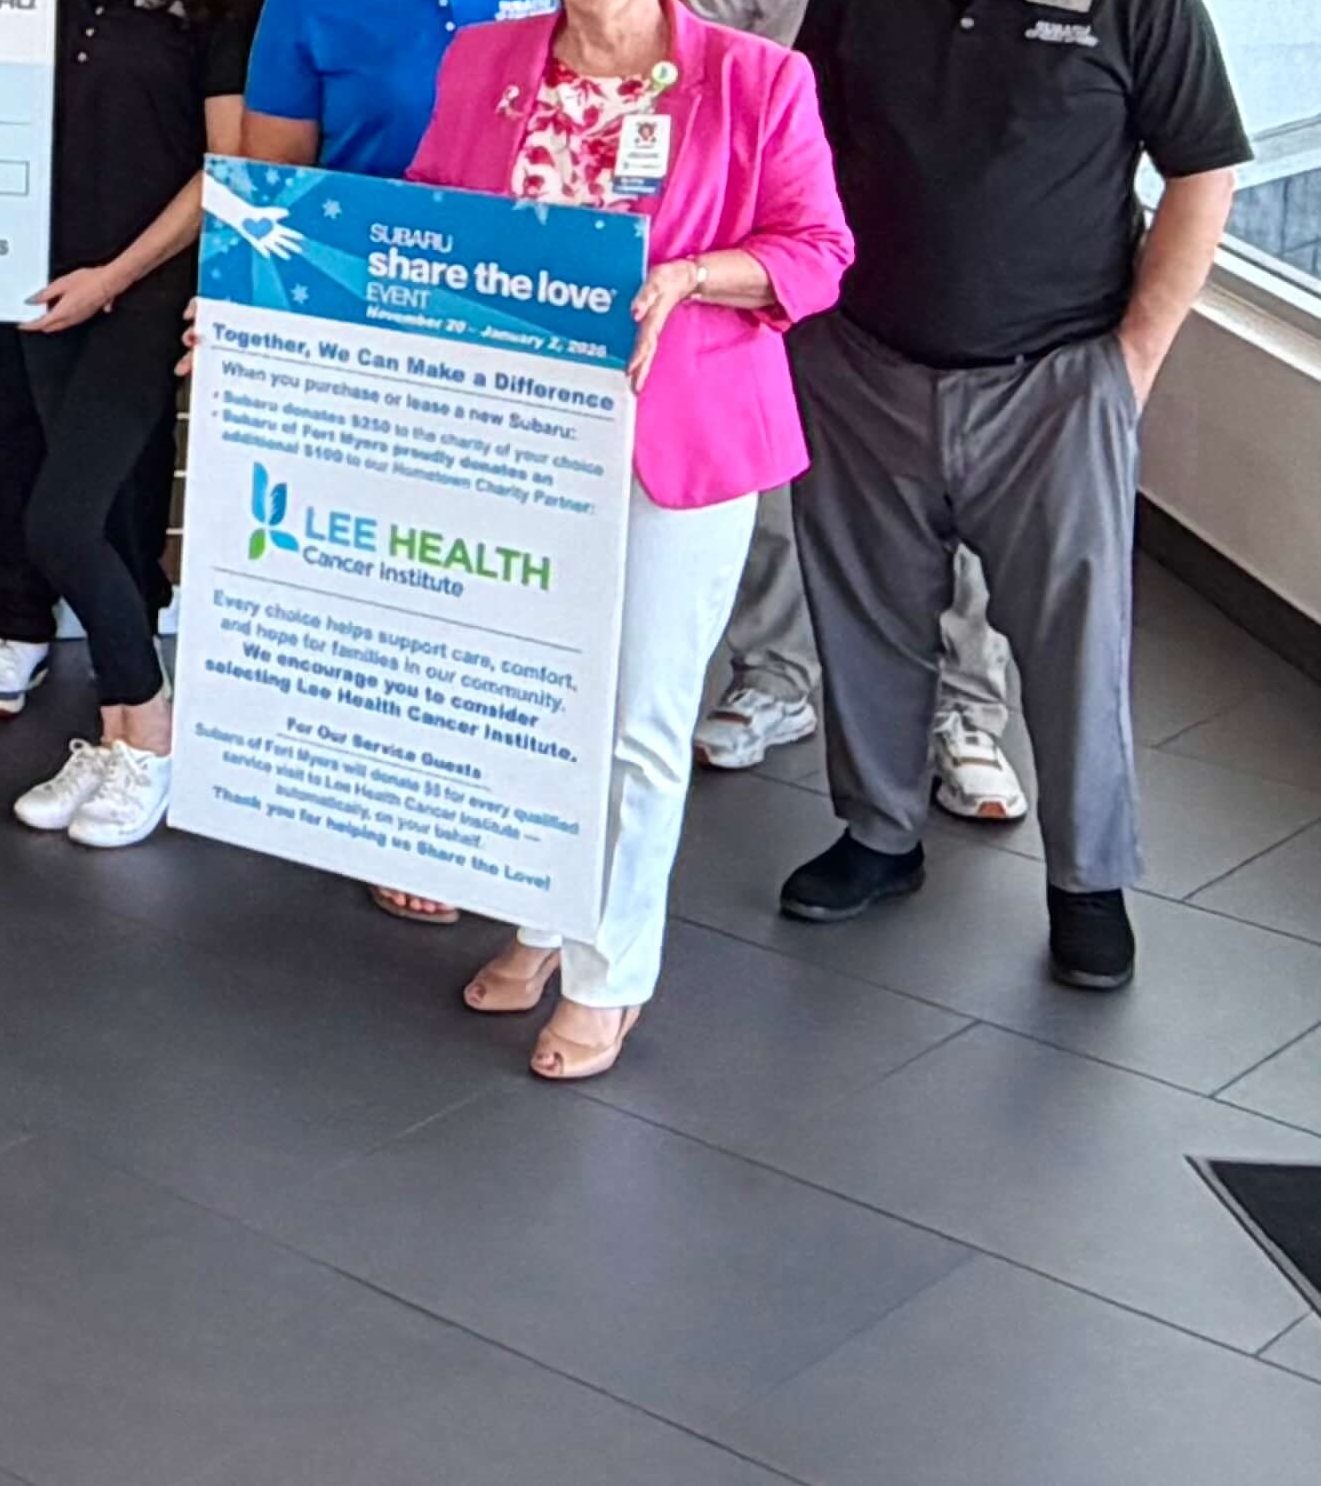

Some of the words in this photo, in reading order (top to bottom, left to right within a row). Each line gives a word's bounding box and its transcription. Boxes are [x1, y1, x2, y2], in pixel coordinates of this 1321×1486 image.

[368, 246, 469, 290] share
[473, 262, 533, 301] the
[537, 270, 615, 313] love
[370, 223, 453, 254] SUBARU
[366, 281, 431, 309] EVENT
[212, 321, 311, 359] Together,
[317, 340, 351, 363] We
[357, 347, 400, 372] Can
[406, 356, 466, 383] Make
[472, 372, 487, 388] a
[493, 371, 615, 411] Difference
[221, 360, 267, 382] When
[269, 372, 301, 389] you
[303, 377, 381, 404] purchase
[383, 392, 403, 407] or
[405, 393, 451, 417] lease
[453, 405, 466, 420] a
[468, 408, 505, 427] new
[508, 411, 576, 441] Subaru:
[221, 407, 278, 432] Subaru
[280, 421, 298, 435] of
[301, 423, 336, 443] Fort
[338, 430, 390, 454] Myers
[391, 443, 456, 470] proudly
[458, 455, 528, 482] donates
[531, 471, 555, 487] an
[221, 429, 300, 455] additional
[344, 452, 362, 468] to
[363, 457, 389, 473] our
[391, 460, 472, 490] Hometown
[474, 477, 530, 505] Charity
[532, 488, 596, 515] Partner:
[222, 389, 279, 413] Subaru
[281, 401, 347, 426] donates
[394, 423, 410, 438] to
[411, 426, 437, 443] the
[439, 433, 492, 455] charity
[493, 442, 511, 457] of
[514, 449, 550, 465] your
[551, 455, 605, 477] choice
[301, 544, 375, 577] Cancer
[379, 561, 465, 598] Institute
[304, 505, 378, 553] LEE
[388, 523, 551, 592] HEALTH
[213, 588, 261, 618] Every
[264, 603, 323, 630] choice
[325, 615, 374, 642] helps
[377, 630, 448, 660] support
[450, 648, 496, 673] care,
[219, 617, 252, 637] and
[255, 622, 300, 648] hope
[301, 632, 327, 654] for
[331, 639, 400, 672] families
[403, 655, 421, 676] in
[424, 666, 457, 685] our
[460, 673, 566, 714] community.
[205, 658, 292, 695] selecting
[296, 677, 333, 701] Lee
[337, 687, 402, 718] Health
[406, 705, 480, 737] Cancer
[483, 723, 578, 763] Institute.
[242, 641, 272, 663] We
[276, 653, 379, 690] encourage
[383, 678, 419, 699] you
[424, 686, 446, 705] to
[449, 695, 540, 728] consider
[286, 716, 313, 736] For
[316, 724, 348, 745] Our
[351, 733, 417, 763] Service
[420, 751, 482, 780] Guests
[212, 785, 262, 811] Thank
[265, 803, 297, 820] you
[298, 807, 322, 827] for
[325, 816, 388, 849] helping
[390, 836, 412, 852] us
[416, 840, 467, 867] Share
[470, 855, 500, 877] the
